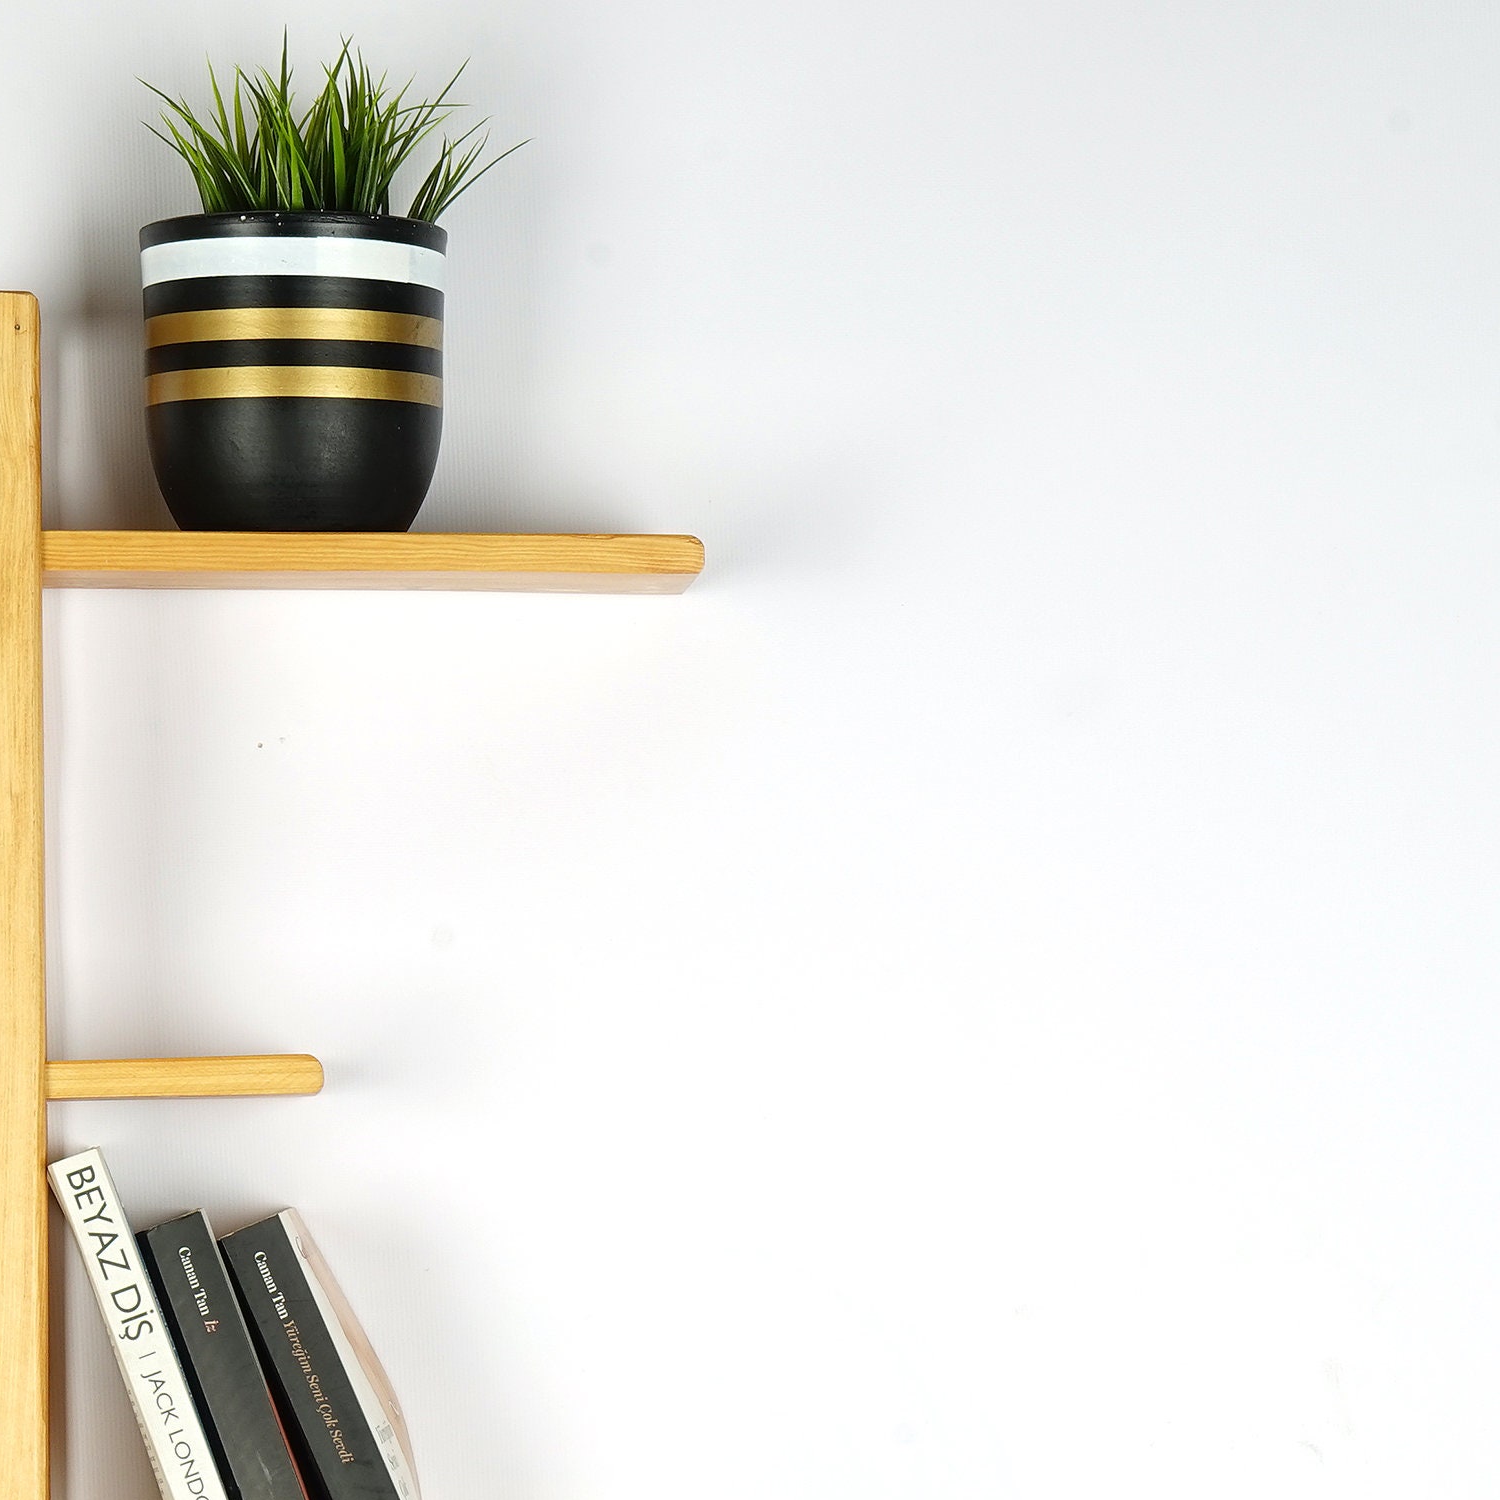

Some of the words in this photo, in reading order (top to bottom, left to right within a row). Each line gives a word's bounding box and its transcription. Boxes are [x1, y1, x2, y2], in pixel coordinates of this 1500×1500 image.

[178, 1246, 200, 1290] Canan
[193, 1288, 210, 1317] Tan
[254, 1251, 277, 1294] Canan
[66, 1165, 132, 1281] BEYAZ
[110, 1283, 155, 1341] DİŞ
[140, 1370, 179, 1426] JACK
[271, 1292, 289, 1320] Tan
[283, 1319, 312, 1374] Yüreğim
[305, 1374, 329, 1404] Seni
[315, 1403, 338, 1429] Çok
[329, 1428, 355, 1464] Sevdi
